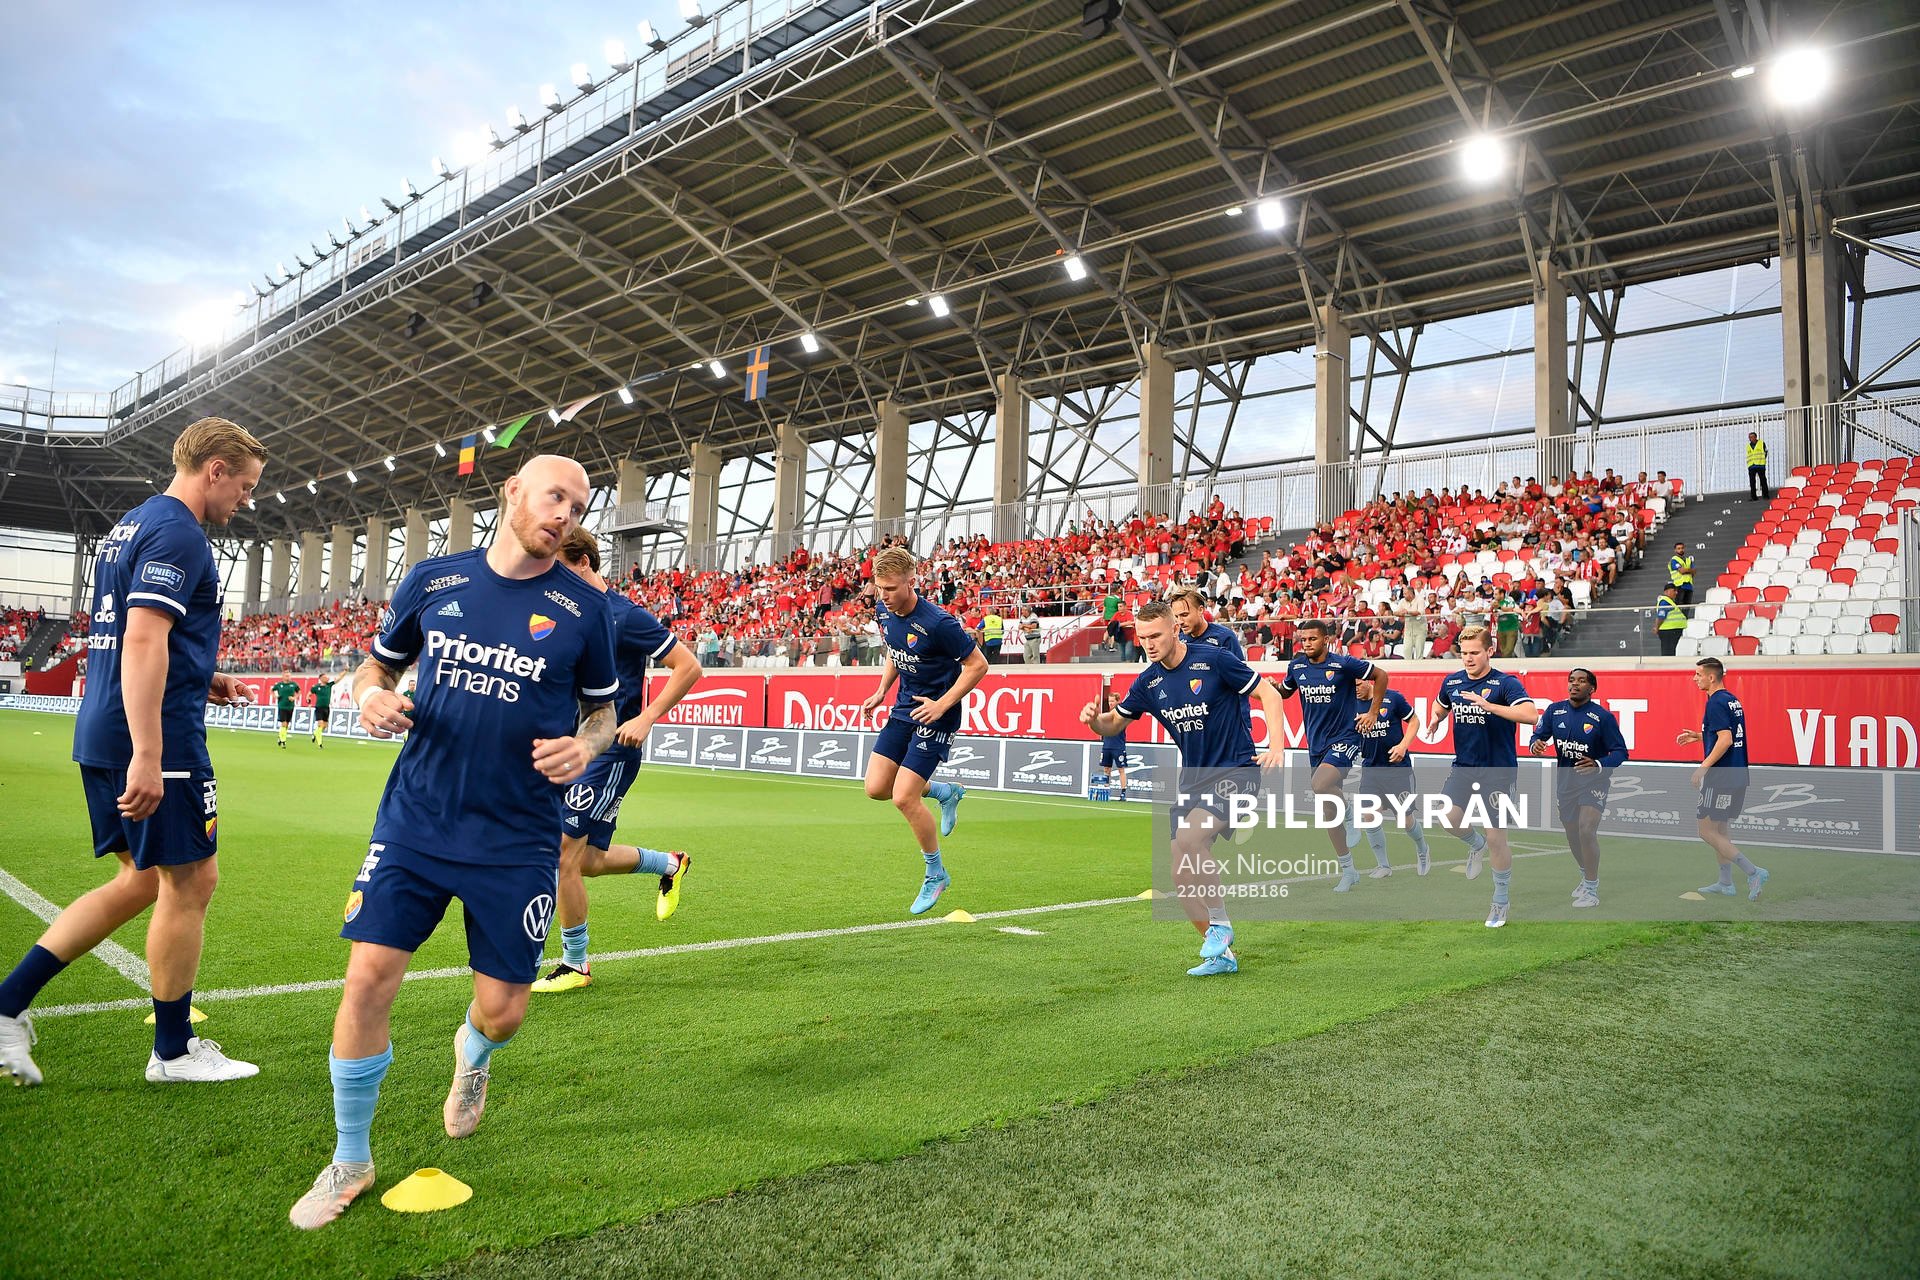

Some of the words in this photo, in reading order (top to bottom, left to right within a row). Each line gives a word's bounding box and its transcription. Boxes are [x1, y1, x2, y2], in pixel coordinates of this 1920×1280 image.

[147, 566, 183, 583] UNIBET
[438, 610, 464, 618] adidas
[1633, 624, 1640, 633] 4
[1619, 639, 1627, 649] 3
[427, 630, 547, 682] Prioritet
[436, 659, 521, 702] Finans
[1300, 684, 1336, 695] Prioritet
[1305, 694, 1331, 704] Finans
[668, 703, 743, 725] GYERMELYI
[783, 690, 895, 732] DIÓSZEG
[1160, 702, 1209, 722] Prioritet
[1451, 702, 1491, 715] Priorite
[1455, 712, 1486, 725] Finans
[936, 767, 958, 775] The
[960, 768, 991, 777] Hotel
[1013, 771, 1037, 781] The
[1039, 773, 1073, 782] Hotel
[1616, 807, 1681, 821] Hotel
[1734, 814, 1781, 827] The
[1786, 817, 1861, 831] Hotel
